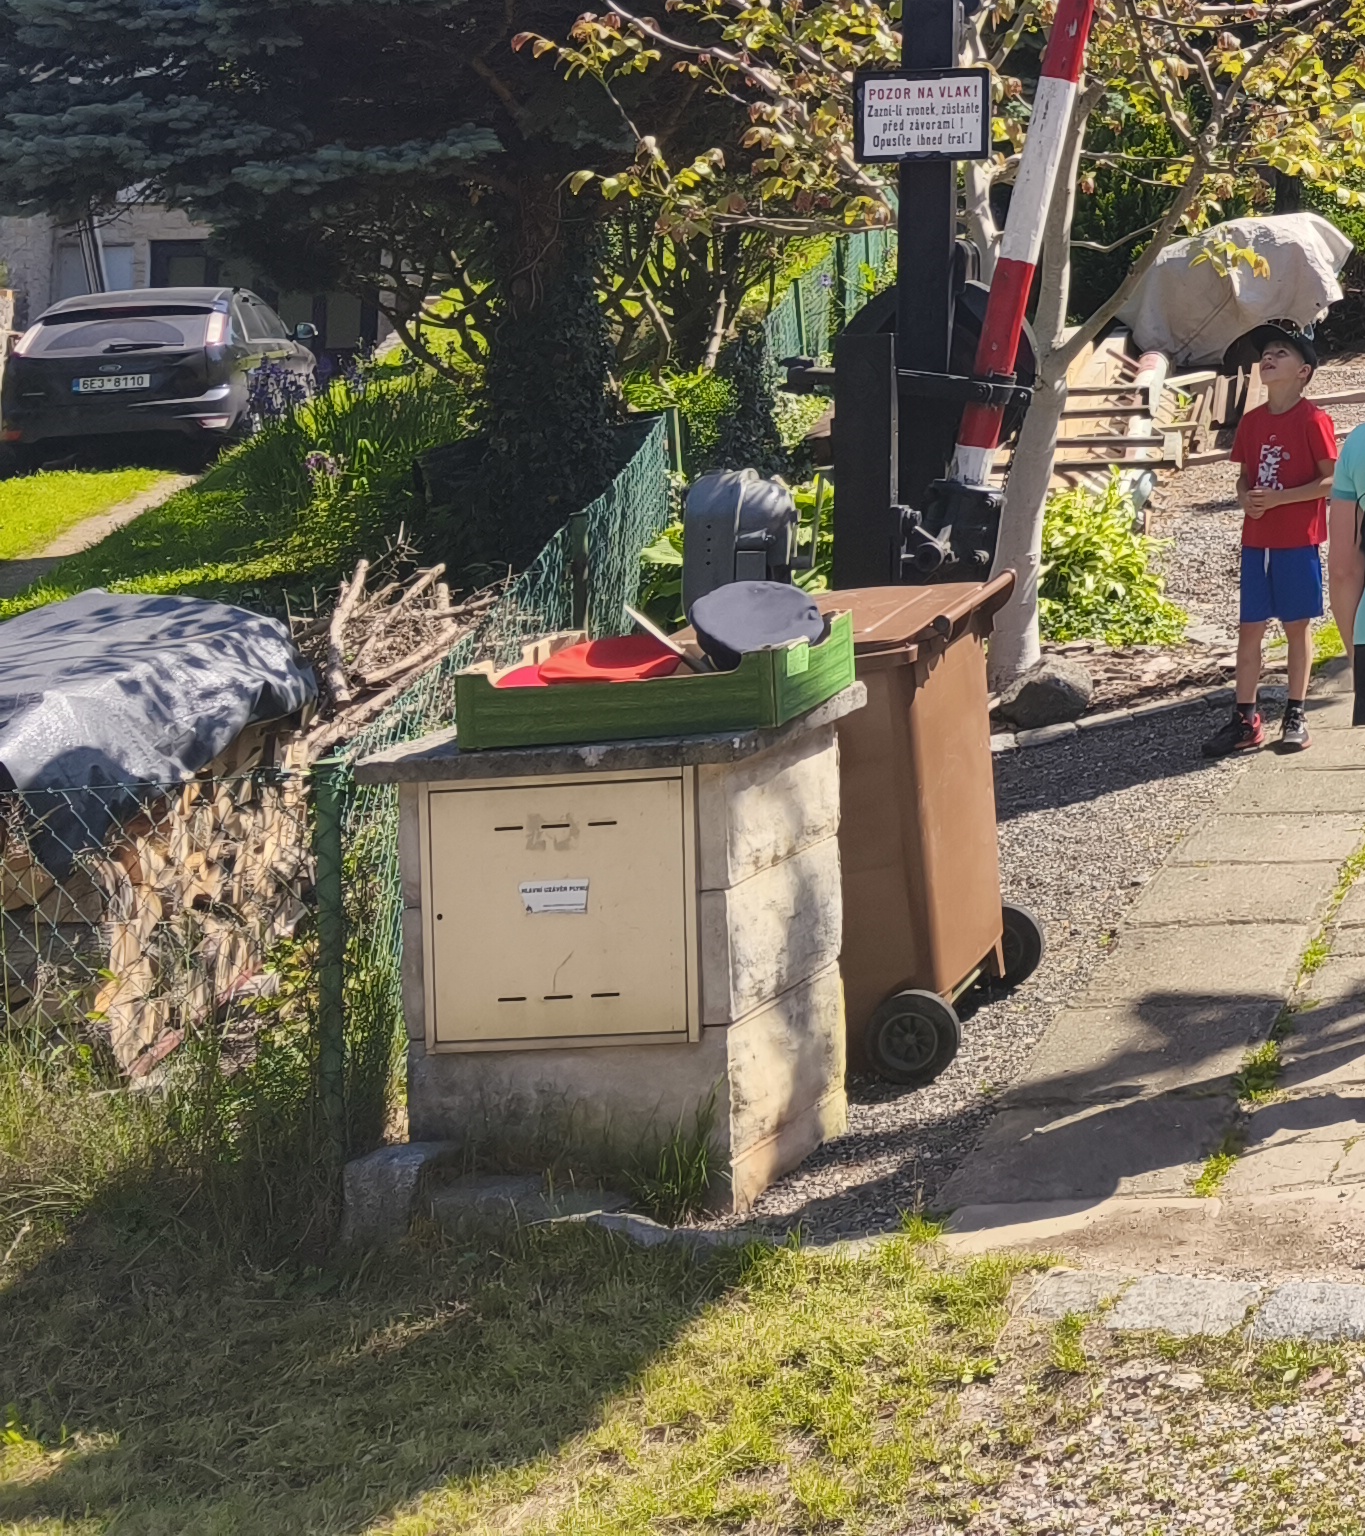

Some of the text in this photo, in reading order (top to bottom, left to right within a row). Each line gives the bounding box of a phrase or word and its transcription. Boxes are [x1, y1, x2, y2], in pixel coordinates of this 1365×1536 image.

[869, 85, 978, 100] POZOR NA VLAK!
[882, 119, 904, 134] před
[82, 376, 144, 390] 6E3 8110
